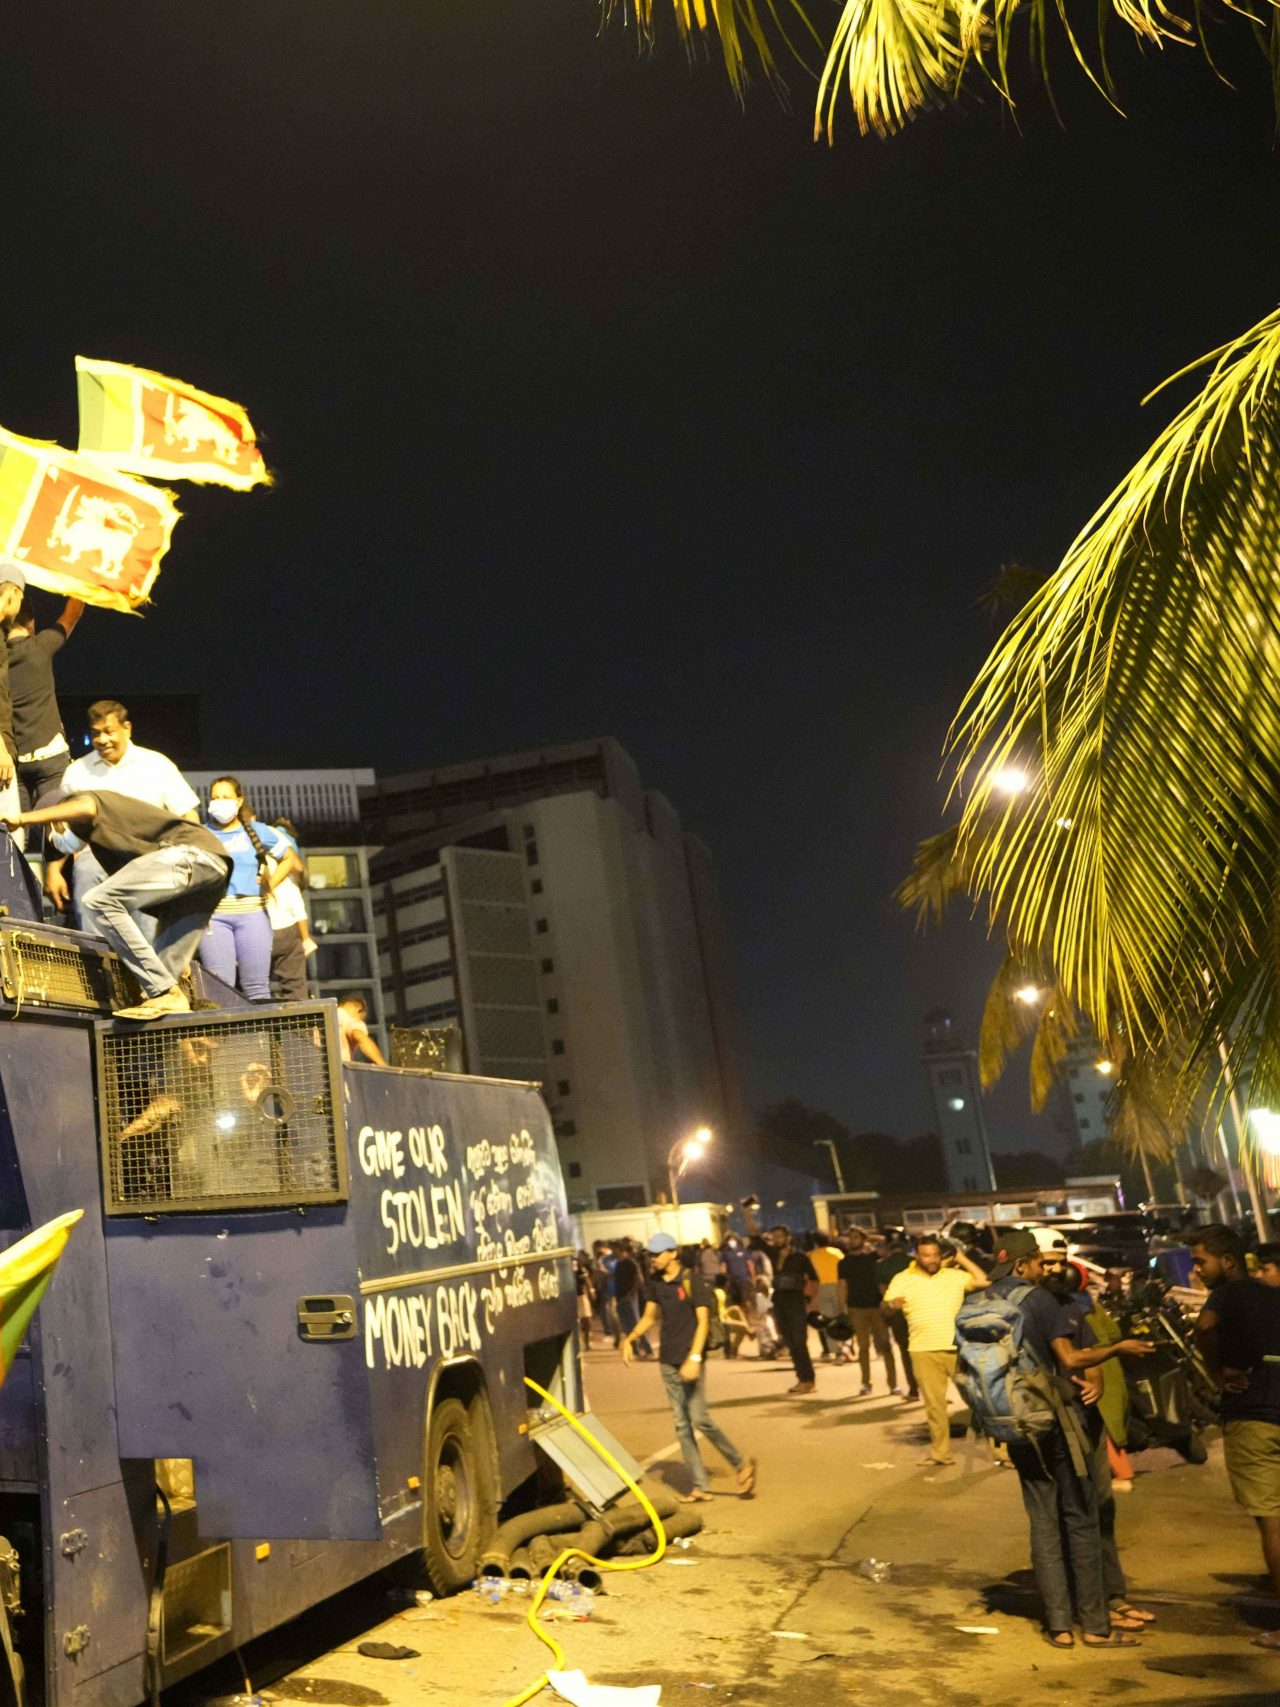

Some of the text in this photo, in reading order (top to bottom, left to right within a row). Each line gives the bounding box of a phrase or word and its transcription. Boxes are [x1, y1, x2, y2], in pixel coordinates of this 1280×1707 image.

[358, 1126, 405, 1179] GIVE
[408, 1124, 448, 1178] OUR
[381, 1179, 465, 1255] STOLEN
[365, 1294, 432, 1370] MONEY
[435, 1282, 481, 1358] BACK
